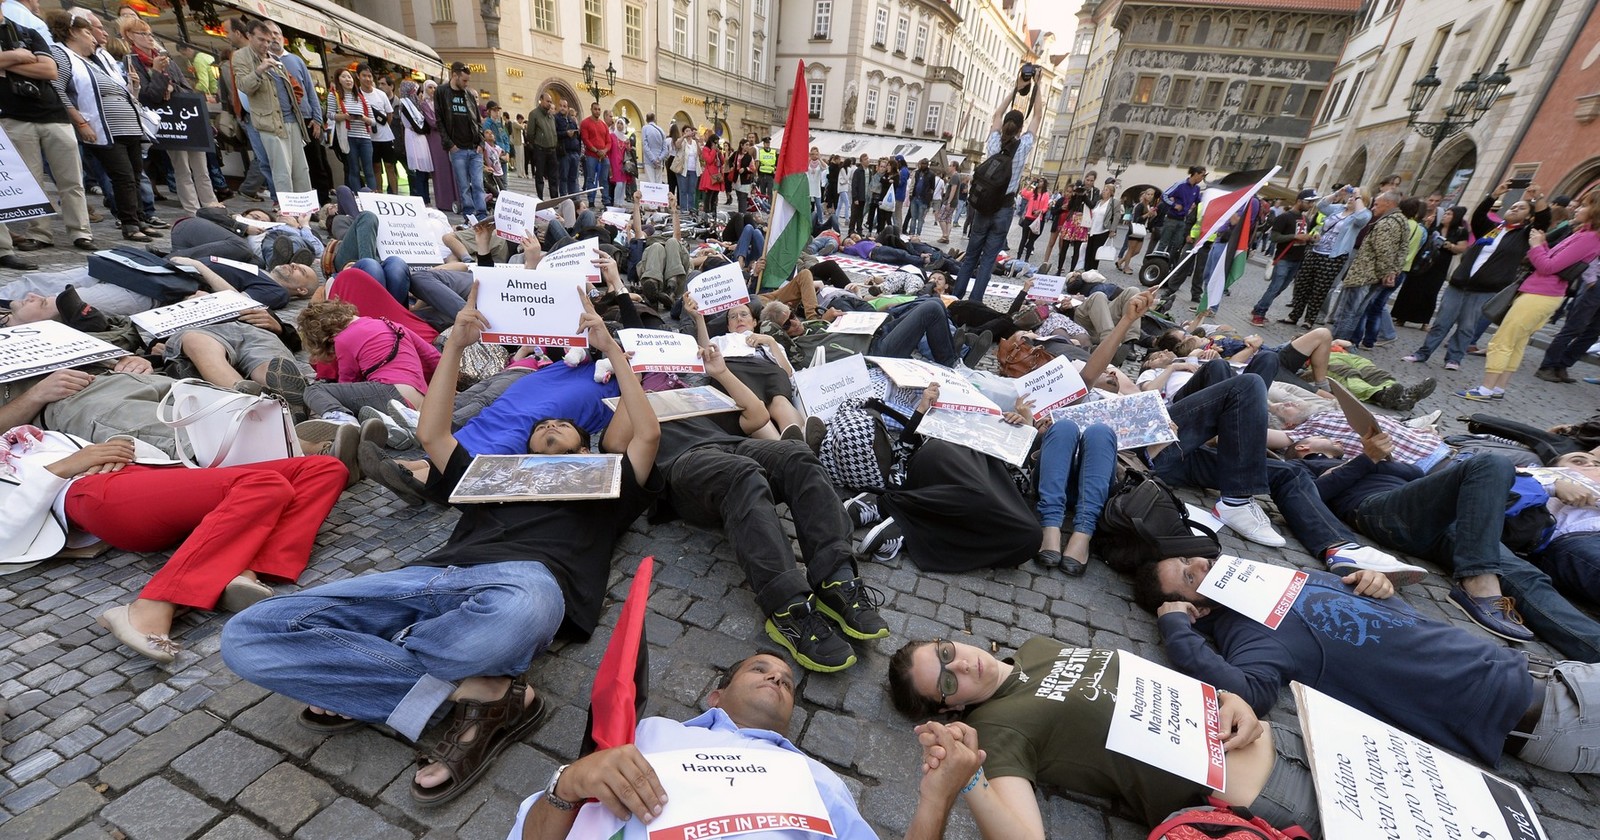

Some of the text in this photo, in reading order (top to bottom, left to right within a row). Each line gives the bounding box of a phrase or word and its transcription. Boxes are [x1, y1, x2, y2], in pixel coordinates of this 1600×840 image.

[175, 121, 188, 131] לא
[375, 200, 417, 217] BDS
[390, 230, 419, 238] bojkotu
[507, 279, 547, 290] Ahmed
[701, 274, 721, 283] Mussa
[501, 292, 555, 304] Hamouda
[709, 295, 732, 304] months
[714, 286, 731, 295] Jarad
[154, 295, 218, 315] BDS
[522, 307, 535, 316] 10
[540, 338, 570, 346] PEACE
[819, 376, 855, 395] Suspend the
[1024, 364, 1064, 388] Ahlam Mussa
[1032, 373, 1064, 393] Abu Jarad
[809, 383, 874, 416] Association Agreement
[1040, 407, 1052, 417] REST
[1060, 393, 1078, 405] PEACE
[1214, 565, 1237, 590] Emad
[1237, 564, 1257, 583] Elwan
[1274, 598, 1291, 617] REST
[1290, 576, 1305, 593] PEACE
[1034, 660, 1068, 697] FREEDOM
[1130, 677, 1147, 721] Nagham
[1148, 680, 1162, 735] Mahmoud
[1168, 686, 1182, 744] al-Zouaydi
[1185, 718, 1197, 728] 2
[1206, 696, 1222, 768] REST IN PEACE
[695, 753, 742, 761] Omar
[1362, 735, 1389, 799] okupace
[1387, 729, 1416, 789] všechny
[682, 763, 767, 773] Hamouda
[1411, 740, 1457, 816] uprchlíků
[725, 777, 735, 787] 7
[1334, 753, 1363, 821] Žádáme
[1405, 793, 1433, 829] pro
[683, 815, 810, 840] REST IN PEACE
